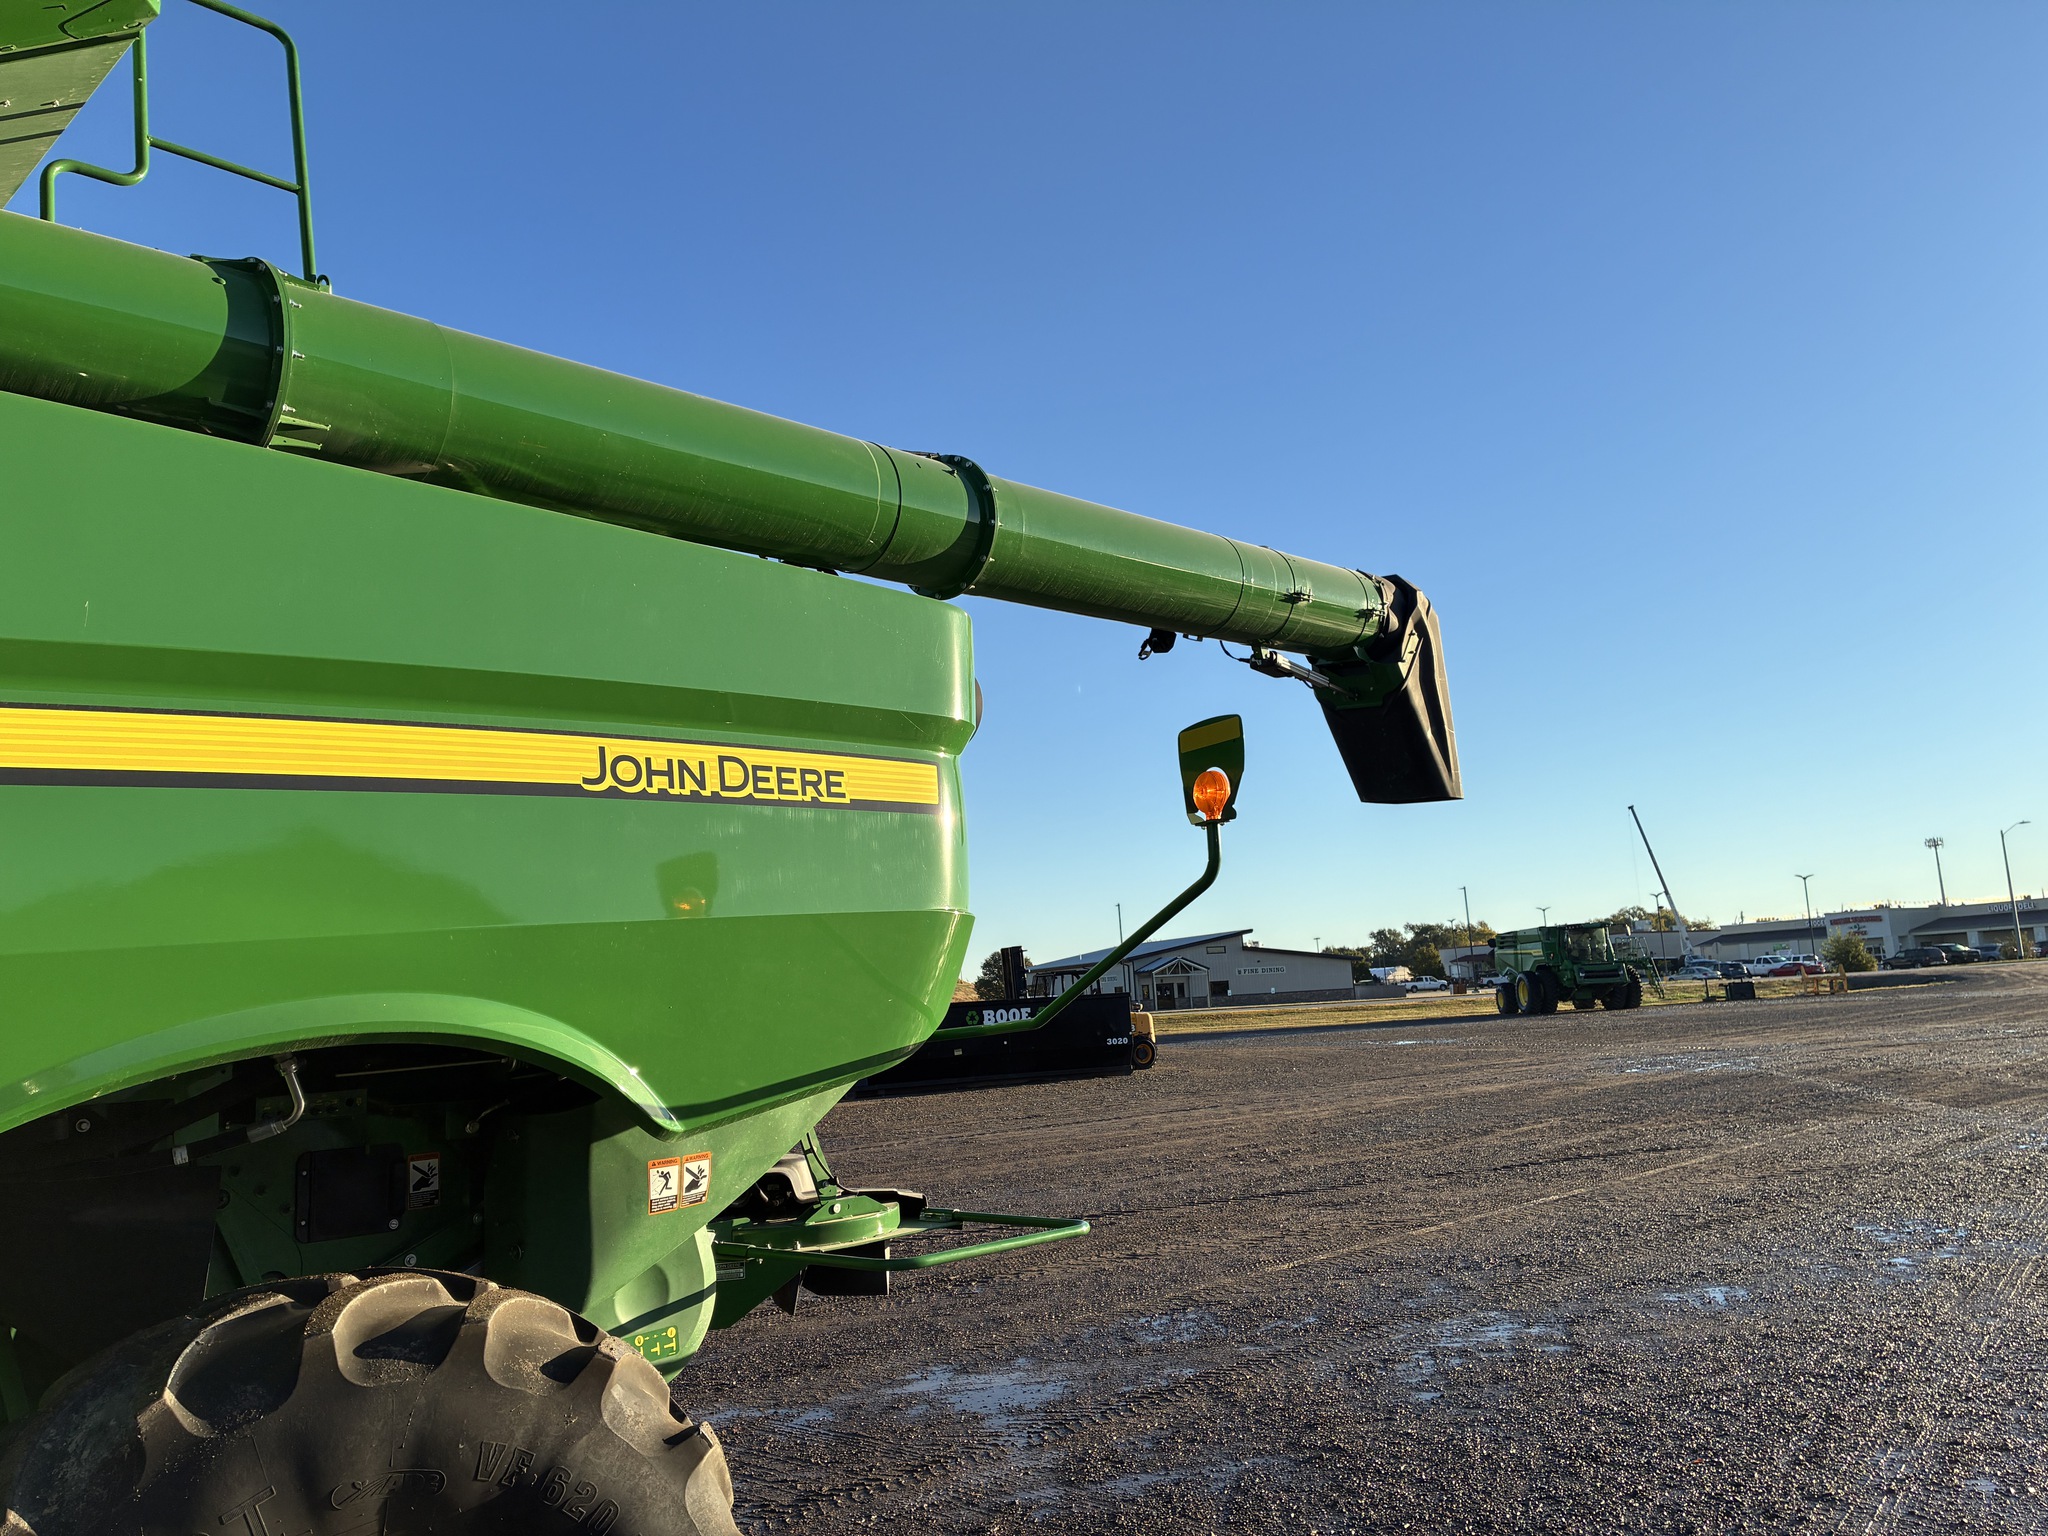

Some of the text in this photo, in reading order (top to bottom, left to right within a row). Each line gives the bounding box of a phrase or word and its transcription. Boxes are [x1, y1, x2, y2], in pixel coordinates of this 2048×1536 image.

[581, 745, 847, 799] JOHN DEERE
[1261, 966, 1285, 974] DINING
[1106, 1037, 1129, 1046] 3020
[689, 1153, 709, 1161] WARNING
[656, 1158, 678, 1166] WARNING
[539, 1465, 621, 1536] 620
